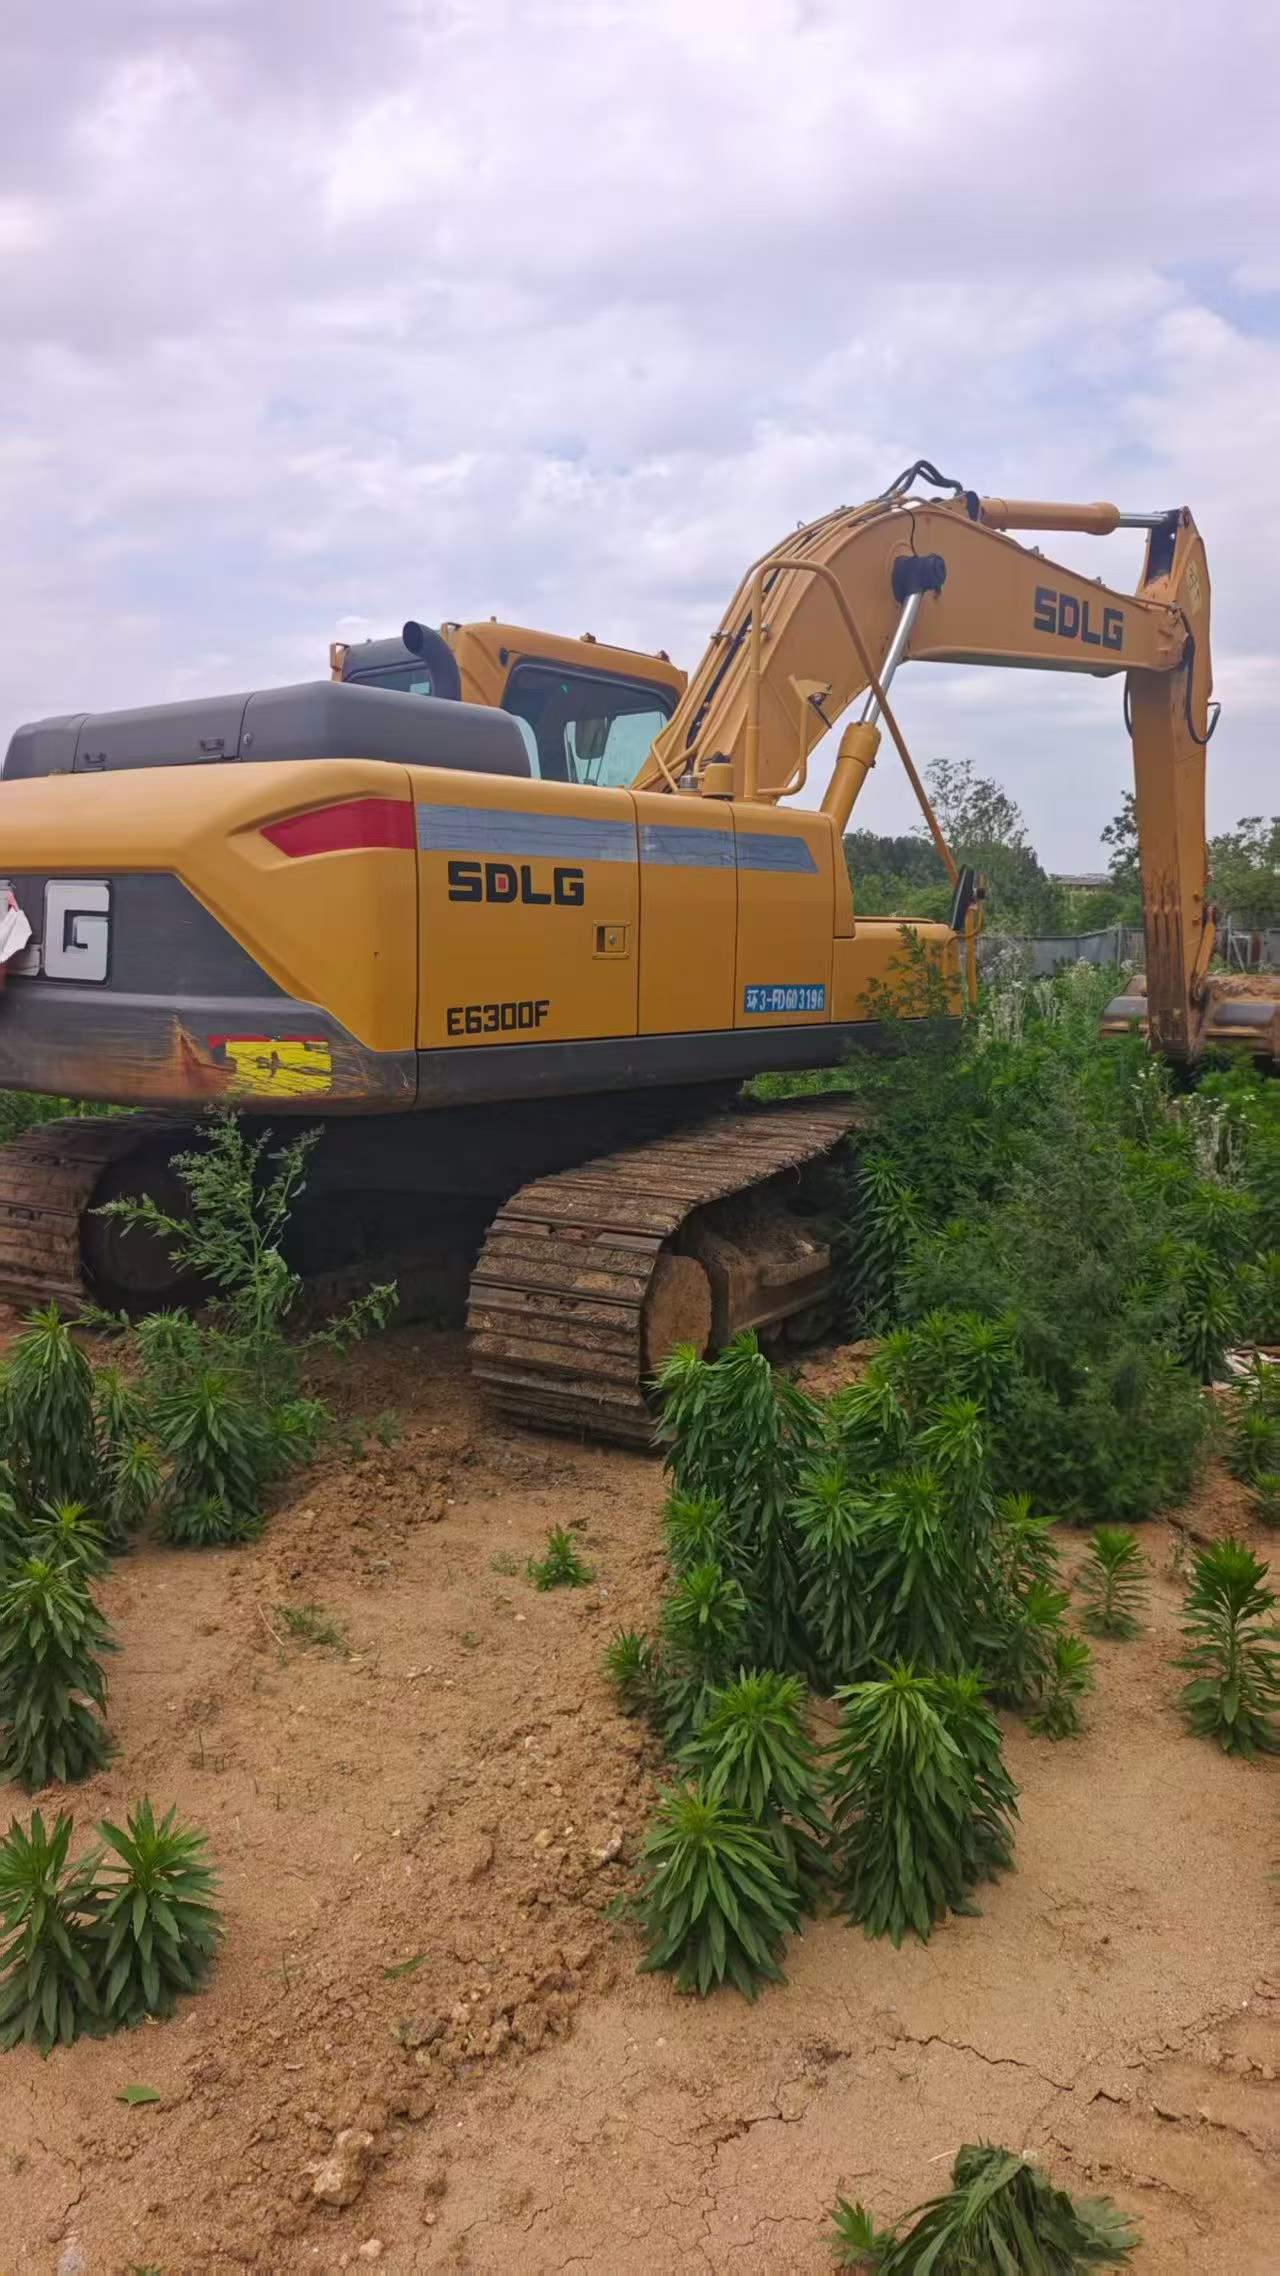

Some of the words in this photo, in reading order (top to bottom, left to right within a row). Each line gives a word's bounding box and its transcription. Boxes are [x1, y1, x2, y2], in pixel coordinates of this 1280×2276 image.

[1034, 585, 1124, 651] SDLG
[448, 861, 584, 906] SDLG
[447, 1000, 550, 1036] E6300F
